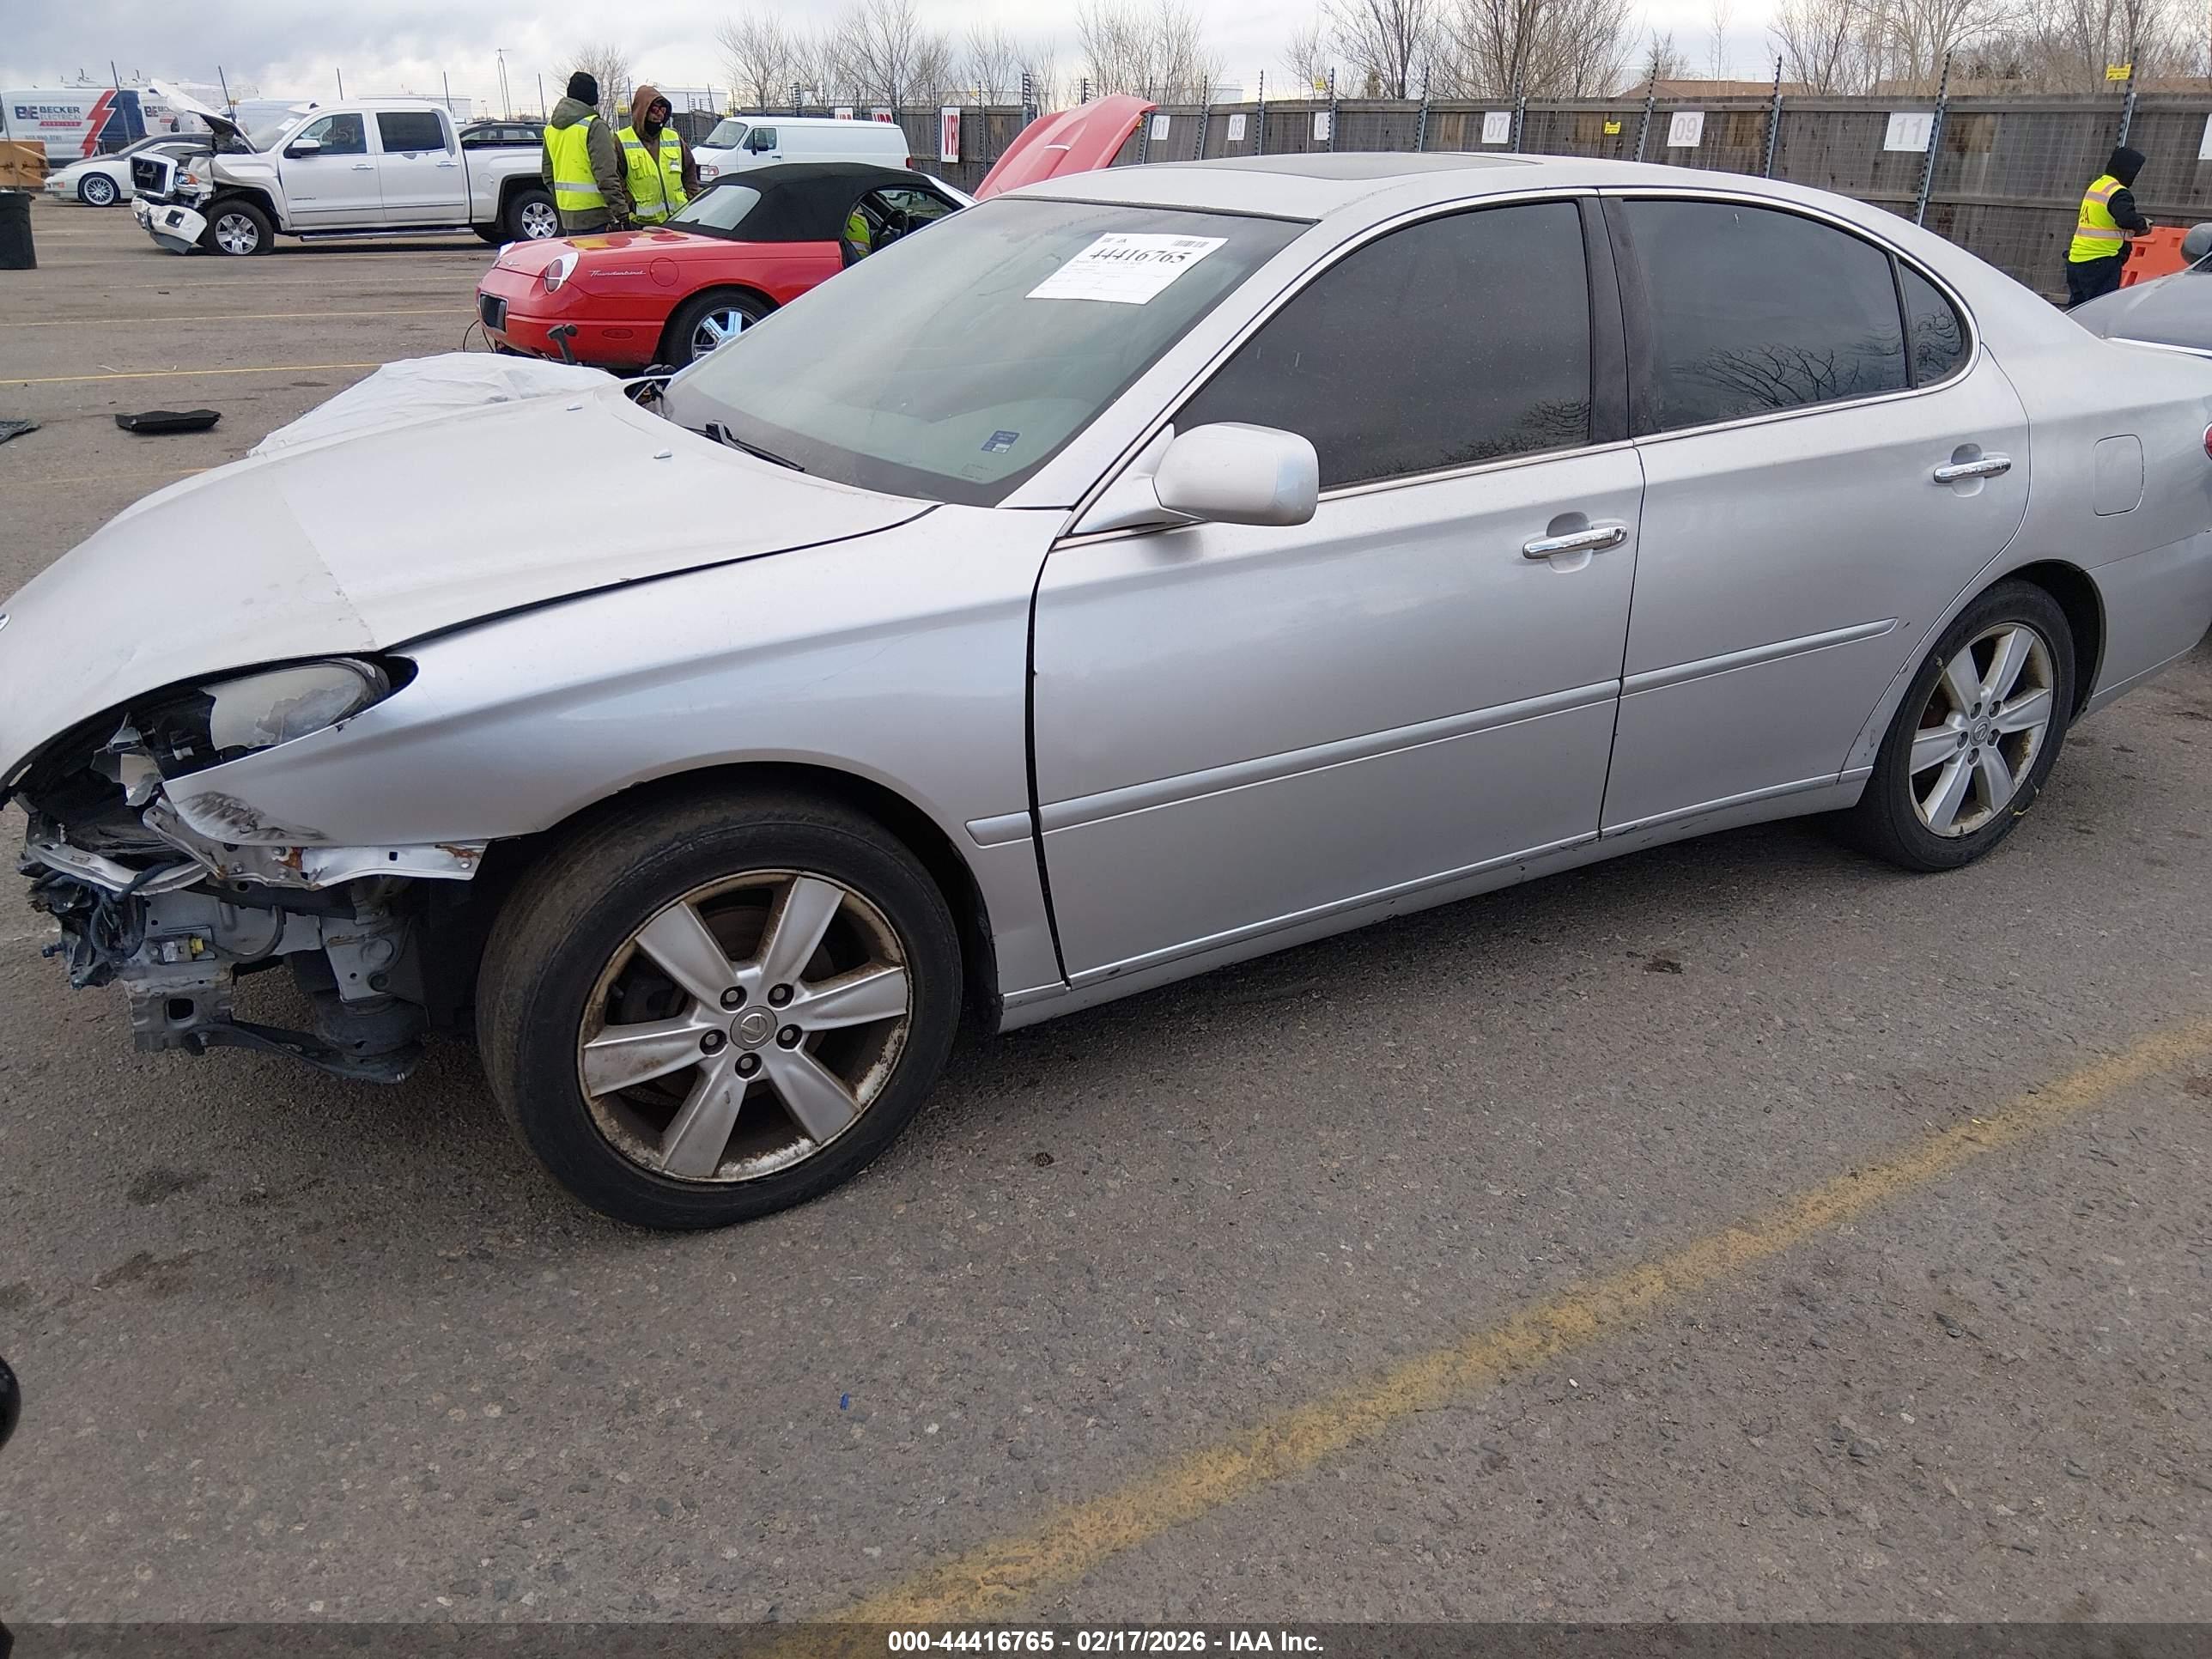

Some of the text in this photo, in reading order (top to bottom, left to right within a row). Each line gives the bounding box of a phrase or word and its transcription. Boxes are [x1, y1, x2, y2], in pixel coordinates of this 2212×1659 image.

[1154, 121, 1166, 135] 01
[1231, 118, 1243, 137] 03
[1487, 116, 1506, 138] 07
[1674, 118, 1698, 141] 09
[1897, 118, 1923, 144] 11
[1089, 247, 1192, 264] 44416765
